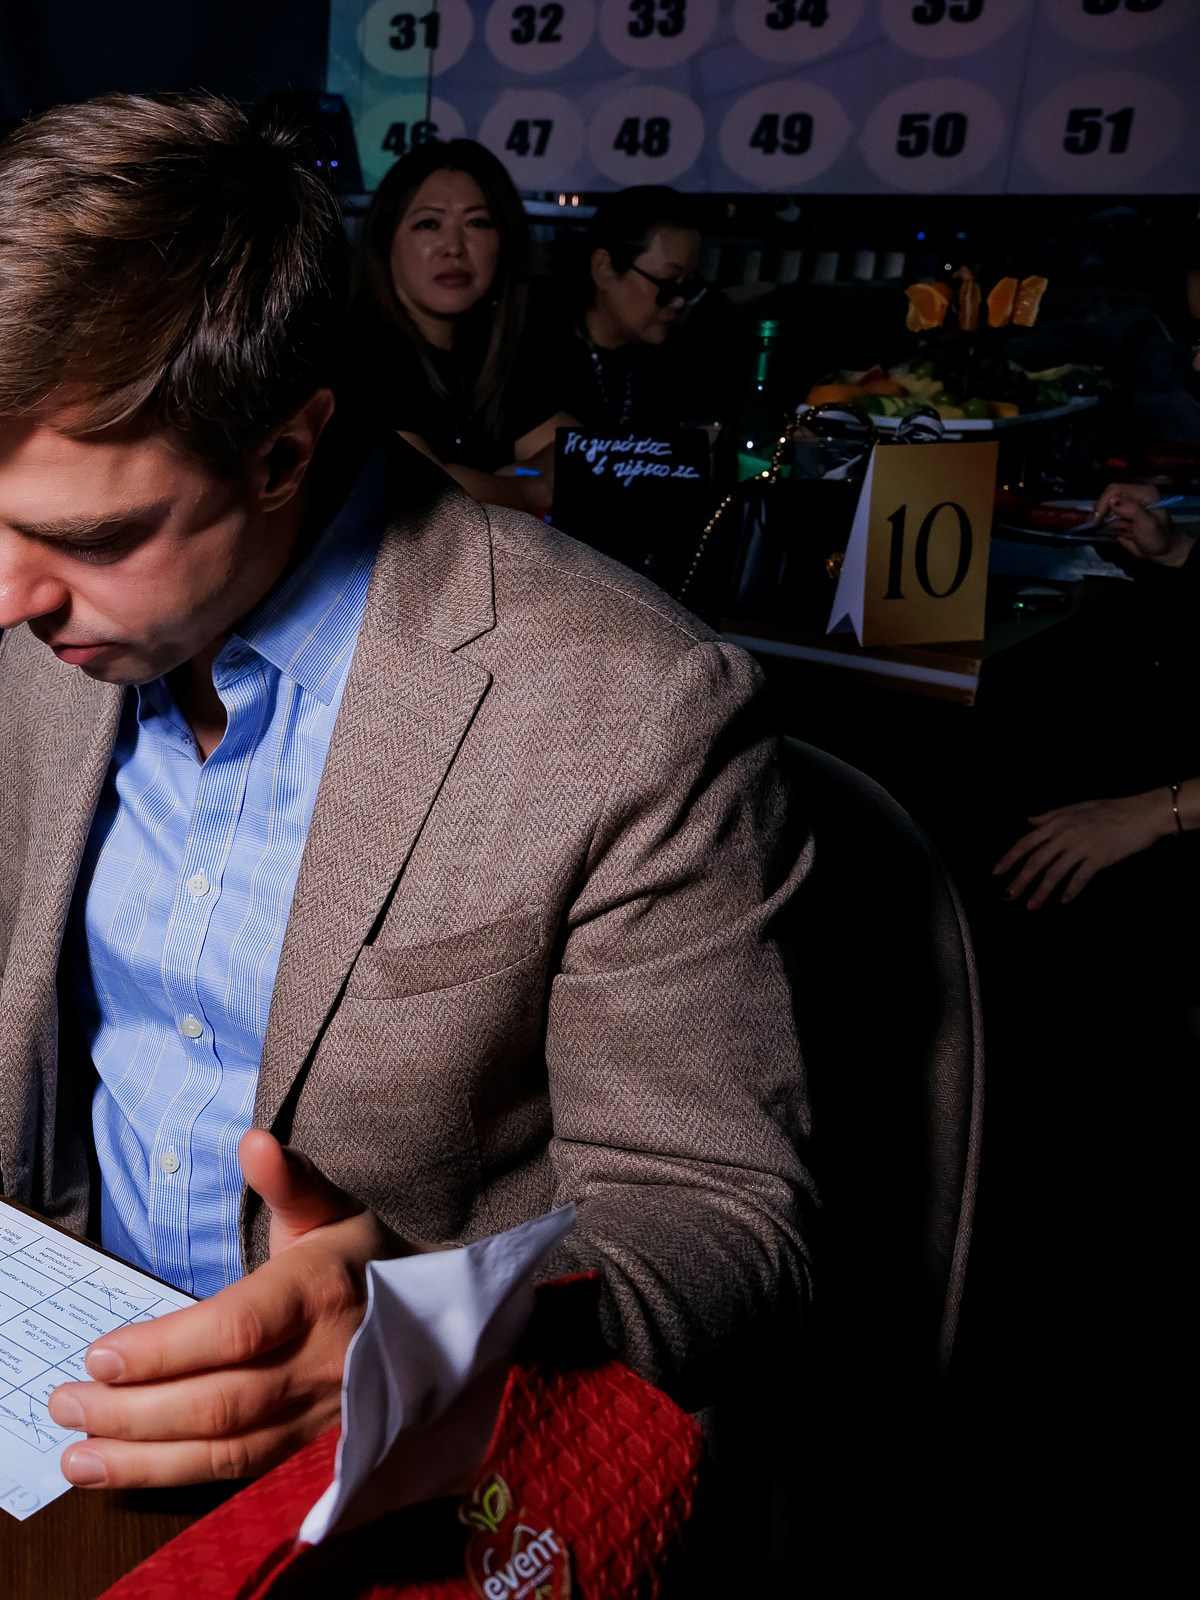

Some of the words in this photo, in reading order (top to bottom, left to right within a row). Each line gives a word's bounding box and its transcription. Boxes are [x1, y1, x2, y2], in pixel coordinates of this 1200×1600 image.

[389, 12, 440, 50] 31
[511, 5, 563, 43] 32
[628, 0, 686, 37] 33
[766, 0, 829, 29] 34
[506, 120, 553, 156] 47
[614, 117, 671, 156] 48
[750, 113, 813, 155] 49
[897, 113, 968, 156] 50
[1063, 108, 1134, 154] 51
[883, 501, 974, 600] 10
[2, 1228, 22, 1240] Bobby
[38, 1251, 67, 1268] хорошем
[19, 1280, 47, 1297] Потолок
[97, 1286, 119, 1300] Happy
[111, 1286, 128, 1296] year
[68, 1302, 99, 1322] moments
[122, 1300, 141, 1311] Abba
[21, 1318, 40, 1331] Song
[68, 1311, 89, 1325] Como
[24, 1329, 40, 1341] Cola
[87, 1322, 106, 1335] Perry
[38, 1328, 71, 1349] Christmas
[39, 1338, 56, 1350] Coca
